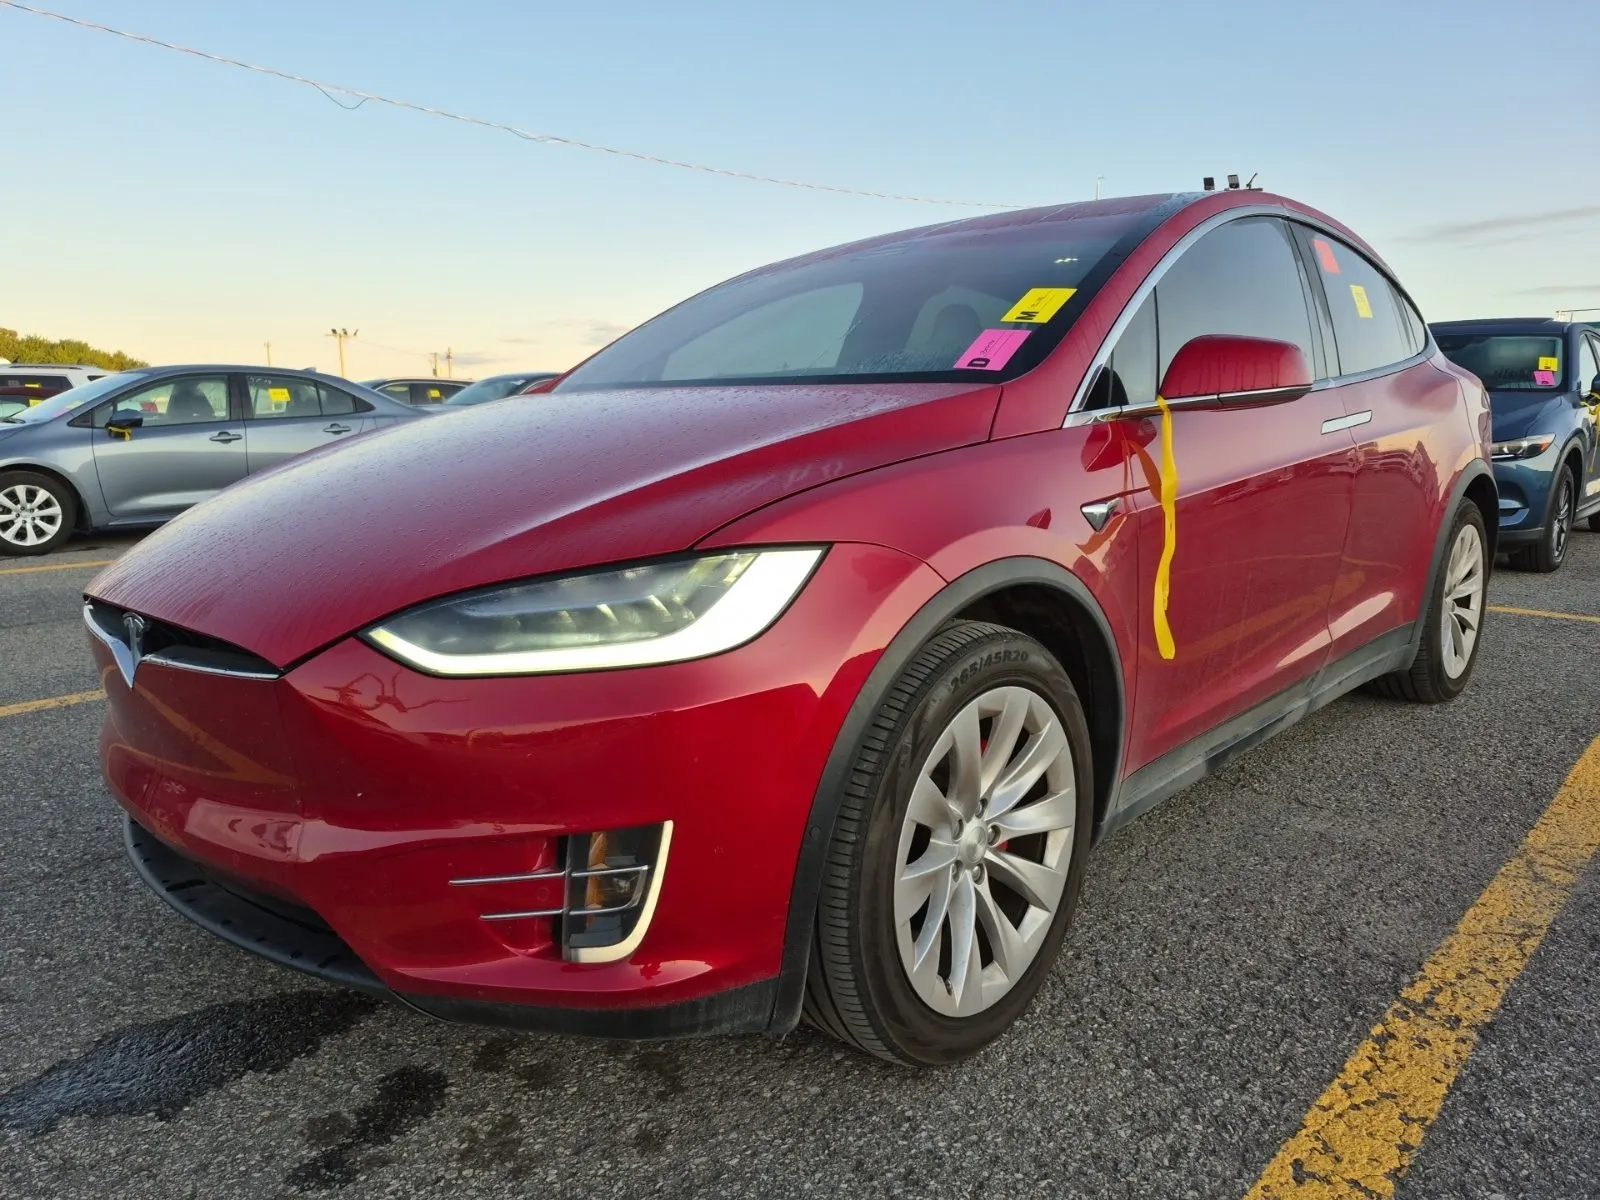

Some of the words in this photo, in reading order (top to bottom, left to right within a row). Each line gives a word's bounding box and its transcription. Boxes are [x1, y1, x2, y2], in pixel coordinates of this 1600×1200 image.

[1015, 311, 1040, 321] M
[966, 357, 991, 368] D
[950, 649, 1029, 692] 265/45R20
